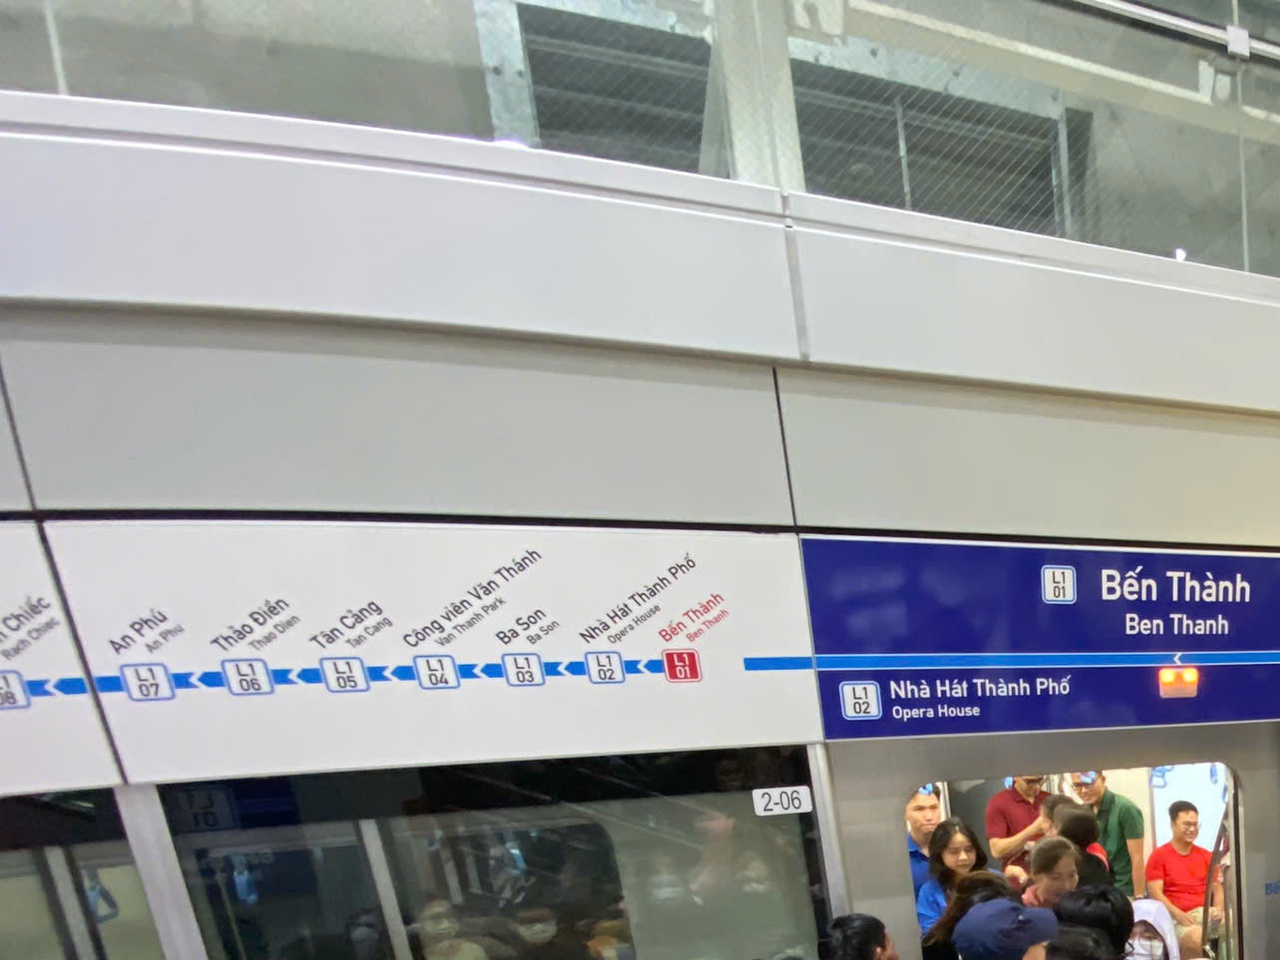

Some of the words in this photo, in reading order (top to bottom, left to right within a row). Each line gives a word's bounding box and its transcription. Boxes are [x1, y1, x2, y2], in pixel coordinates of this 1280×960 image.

[1052, 571, 1066, 584] L1
[1101, 565, 1157, 601] Bến
[1166, 571, 1250, 603] Thành
[403, 619, 445, 648] Công
[440, 598, 473, 622] viên
[467, 579, 500, 601] Văn
[494, 550, 542, 582] Thánh
[578, 618, 610, 644] Nhà
[606, 602, 633, 627] Hát
[628, 576, 672, 609] Thành
[667, 552, 696, 581] Phố
[1054, 586, 1066, 599] 01
[2, 595, 51, 632] Chiếc
[434, 631, 457, 647] Van
[452, 610, 486, 635] Thanh
[481, 597, 508, 616] Park
[658, 619, 687, 643] Bến
[682, 592, 724, 624] Thành
[109, 634, 135, 654] An
[130, 608, 168, 638] Phú
[249, 630, 278, 651] Thao
[273, 613, 301, 634] Dien
[309, 627, 344, 649] Tân
[339, 601, 383, 630] Cảng
[345, 632, 367, 649] Tan
[363, 616, 394, 637] Cang
[495, 628, 520, 646] Ba
[516, 608, 547, 631] Son
[526, 632, 543, 645] Ba
[539, 620, 561, 636] Son
[607, 621, 636, 645] Opera
[632, 603, 661, 627] House
[685, 625, 705, 643] Ben
[700, 608, 730, 631] Thanh
[1125, 613, 1164, 635] Ben
[1169, 613, 1229, 635] Thanh
[144, 637, 163, 654] An
[158, 624, 184, 645] Phu
[210, 624, 254, 651] Thảo
[333, 661, 353, 675] L1
[426, 659, 445, 672] L1
[513, 657, 531, 670] L1
[596, 655, 612, 668] L1
[674, 653, 690, 665] L1
[135, 668, 157, 682] L1
[235, 663, 256, 677] L1
[429, 673, 449, 686] 04
[516, 671, 534, 683] 03
[598, 669, 615, 681] 02
[677, 666, 691, 679] 01
[139, 684, 160, 697] 07
[239, 678, 261, 692] 06
[336, 676, 358, 689] 05
[890, 680, 930, 699] Nhà
[936, 680, 969, 698] Hát
[973, 678, 1030, 697] Thành
[1036, 675, 1073, 695] Phố
[852, 686, 869, 700] L1
[853, 701, 870, 714] 02
[892, 705, 934, 722] Opera
[938, 704, 980, 718] House
[761, 789, 802, 812] 2-06
